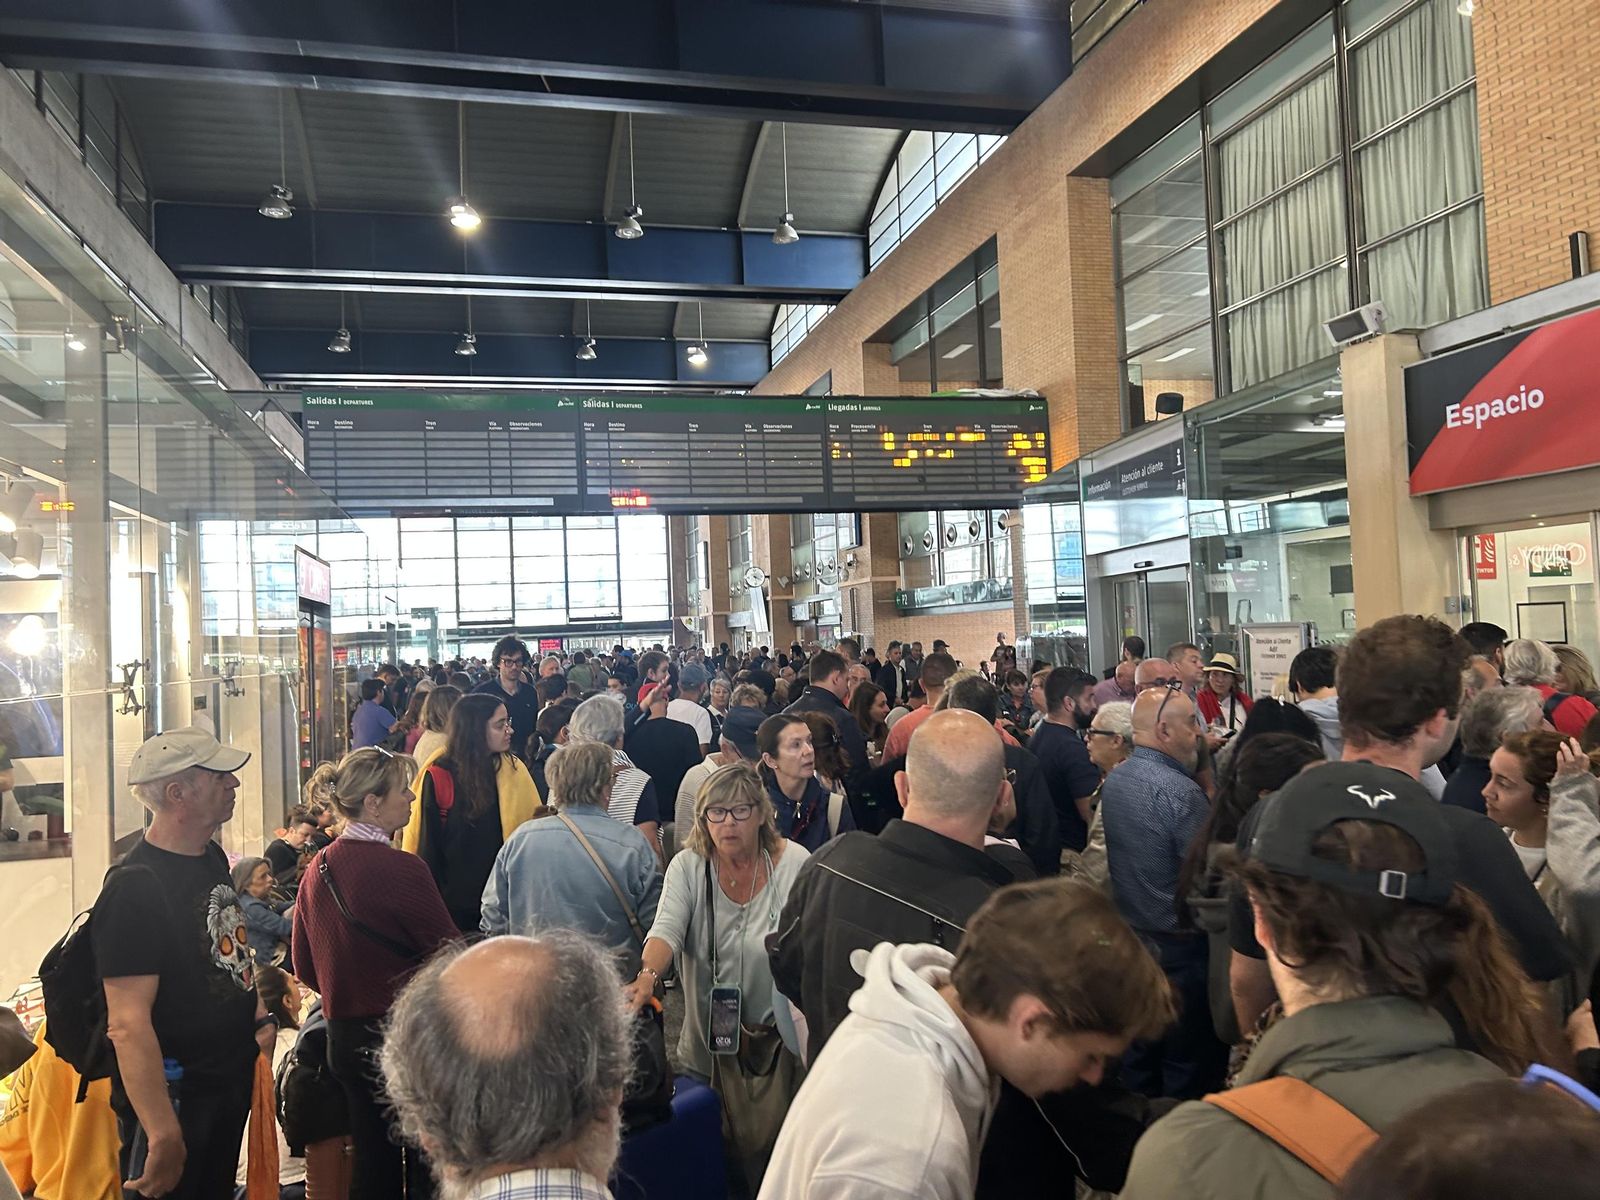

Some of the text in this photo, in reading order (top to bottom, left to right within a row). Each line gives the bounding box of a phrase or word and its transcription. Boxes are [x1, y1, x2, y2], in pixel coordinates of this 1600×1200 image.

[306, 397, 337, 405] Salidas
[582, 400, 610, 408] Salidas
[1445, 384, 1545, 430] Espacio
[828, 404, 858, 413] Llegadas
[1121, 460, 1164, 484] Atención al cliente
[1087, 479, 1112, 496] Información
